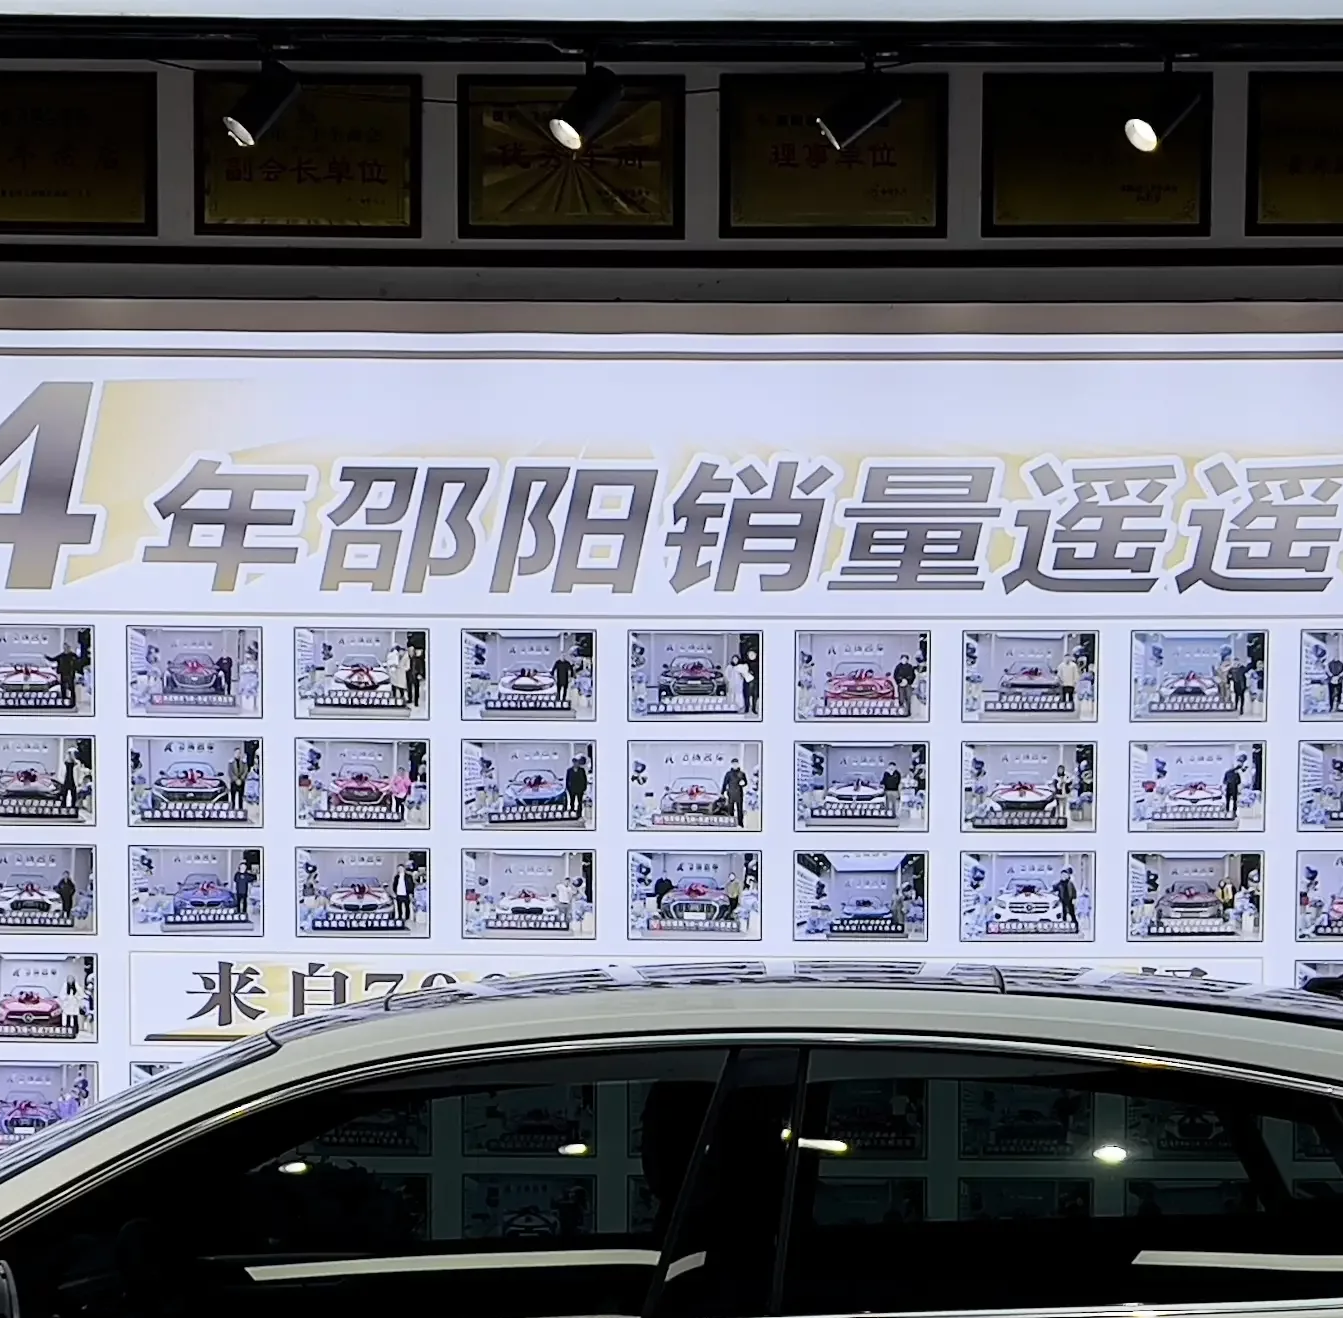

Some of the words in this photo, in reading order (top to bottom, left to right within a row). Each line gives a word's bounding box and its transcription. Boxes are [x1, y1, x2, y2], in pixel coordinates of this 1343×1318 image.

[222, 155, 389, 185] 副会长单位
